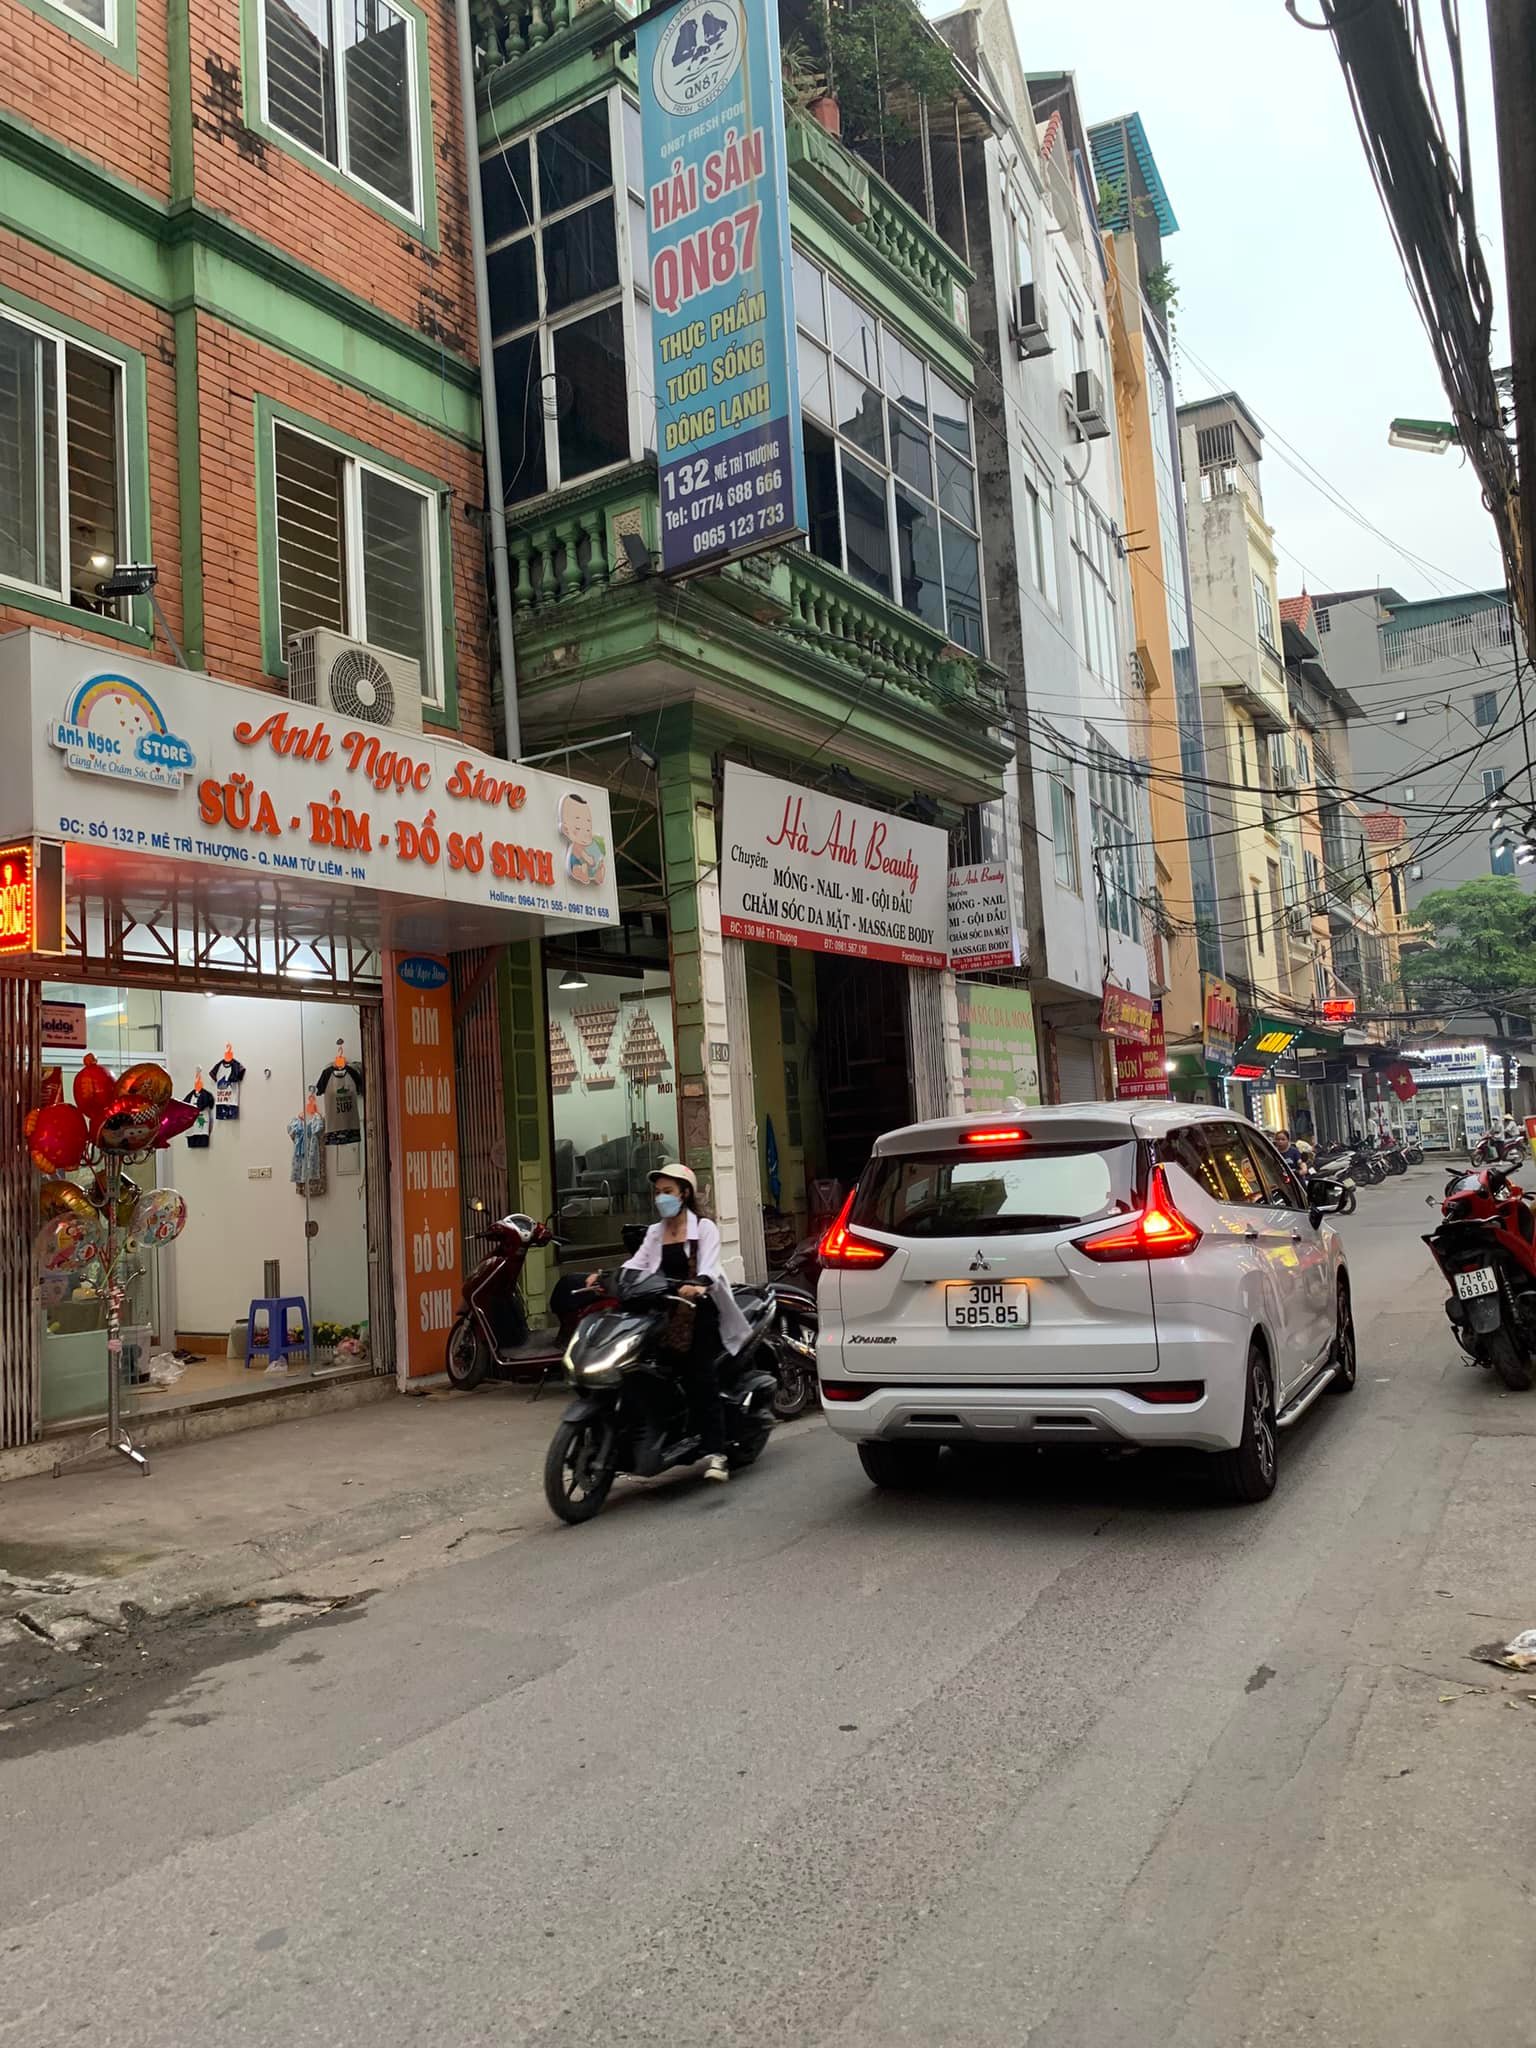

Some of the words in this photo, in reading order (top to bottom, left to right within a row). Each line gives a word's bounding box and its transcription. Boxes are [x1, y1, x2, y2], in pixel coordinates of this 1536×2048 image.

[684, 71, 719, 100] QN87
[687, 117, 720, 144] FRESH
[651, 159, 698, 232] HẢI
[704, 129, 765, 202] SẢN
[653, 203, 762, 316] QN87
[660, 320, 705, 363] THỰC
[710, 289, 767, 341] PHẨM
[666, 363, 707, 405] TƯƠI
[712, 339, 764, 386] SỐNG
[665, 405, 716, 451] ĐÔNG
[720, 382, 770, 430] LẠNH
[664, 458, 710, 500] 132
[729, 453, 744, 477] TRÌ
[743, 440, 780, 471] THƯỢNG
[666, 506, 688, 530] Tel:
[691, 492, 723, 522] 0774
[727, 480, 752, 506] 688
[756, 469, 783, 496] 666
[693, 524, 726, 553] 0965
[729, 513, 755, 540] 123
[757, 502, 785, 530] 733
[58, 725, 84, 748] Anh
[88, 731, 121, 757] Ngọc
[143, 740, 188, 763] STORE
[232, 712, 335, 763] Anh
[341, 731, 432, 795] Ngọc
[446, 760, 528, 811] Store
[70, 754, 92, 769] Cùng
[108, 761, 132, 776] Chăm
[134, 766, 147, 780] Sóc
[150, 771, 165, 781] Con
[167, 773, 181, 785] Yêu
[60, 817, 85, 836] ĐC:
[88, 821, 108, 840] SỐ
[113, 826, 134, 843] 132
[137, 830, 148, 846] P.
[174, 836, 193, 853] TRÌ
[196, 841, 249, 863] THƯỢNG
[258, 852, 270, 866] Q.
[273, 854, 298, 870] NAM
[300, 857, 316, 874] TỪ
[318, 860, 343, 877] LIÊM
[351, 868, 366, 881] HN
[198, 772, 283, 836] SỮA
[307, 789, 373, 853] BỈM
[395, 809, 441, 865] ĐỒ
[447, 831, 485, 874] SƠ
[490, 839, 556, 886] SINH
[766, 795, 809, 855] Hà
[811, 809, 858, 866] Anh
[865, 820, 919, 895] Beauty
[731, 844, 769, 871] Chuyên:
[961, 869, 979, 886] Anh
[980, 866, 1004, 883] Beauty
[518, 895, 535, 907] 0964
[536, 898, 549, 909] 721
[551, 900, 563, 911] 555
[773, 865, 808, 893] MÓNG
[816, 877, 843, 901] NAIL
[851, 886, 864, 905] MI
[872, 890, 890, 913] GỘI
[892, 890, 913, 915] ĐẦU
[947, 898, 975, 912] MÓNG
[982, 894, 1006, 907] NAIL
[730, 920, 743, 934] ĐC:
[743, 924, 755, 937] 130
[776, 930, 798, 946] Thượng
[742, 892, 778, 918] CHĂM
[781, 899, 806, 924] SÓC
[808, 906, 825, 926] DA
[826, 909, 850, 933] MẶT
[858, 916, 907, 942] MASSAGE
[908, 925, 935, 946] BODY
[949, 917, 960, 928] MI
[967, 911, 984, 927] GỘI
[949, 931, 968, 943] CHĂM
[969, 929, 983, 941] SÓC
[983, 927, 994, 937] DA
[995, 926, 1009, 937] MẶT
[951, 943, 987, 956] MASSAGE
[988, 940, 1009, 951] BODY
[411, 995, 440, 1046] BỈM
[405, 1061, 434, 1116] QUẦN
[437, 1069, 450, 1115] ÁO
[1117, 1056, 1138, 1079] BÚN
[431, 1141, 456, 1197] KIỆN
[413, 1217, 432, 1274] ĐỒ
[436, 1227, 454, 1272] SƠ
[420, 1288, 453, 1333] SINH
[969, 1286, 1003, 1304] 30H
[1460, 1280, 1495, 1298] 683.60
[955, 1306, 1019, 1325] 585.85
[848, 1334, 898, 1345] XPANDER
